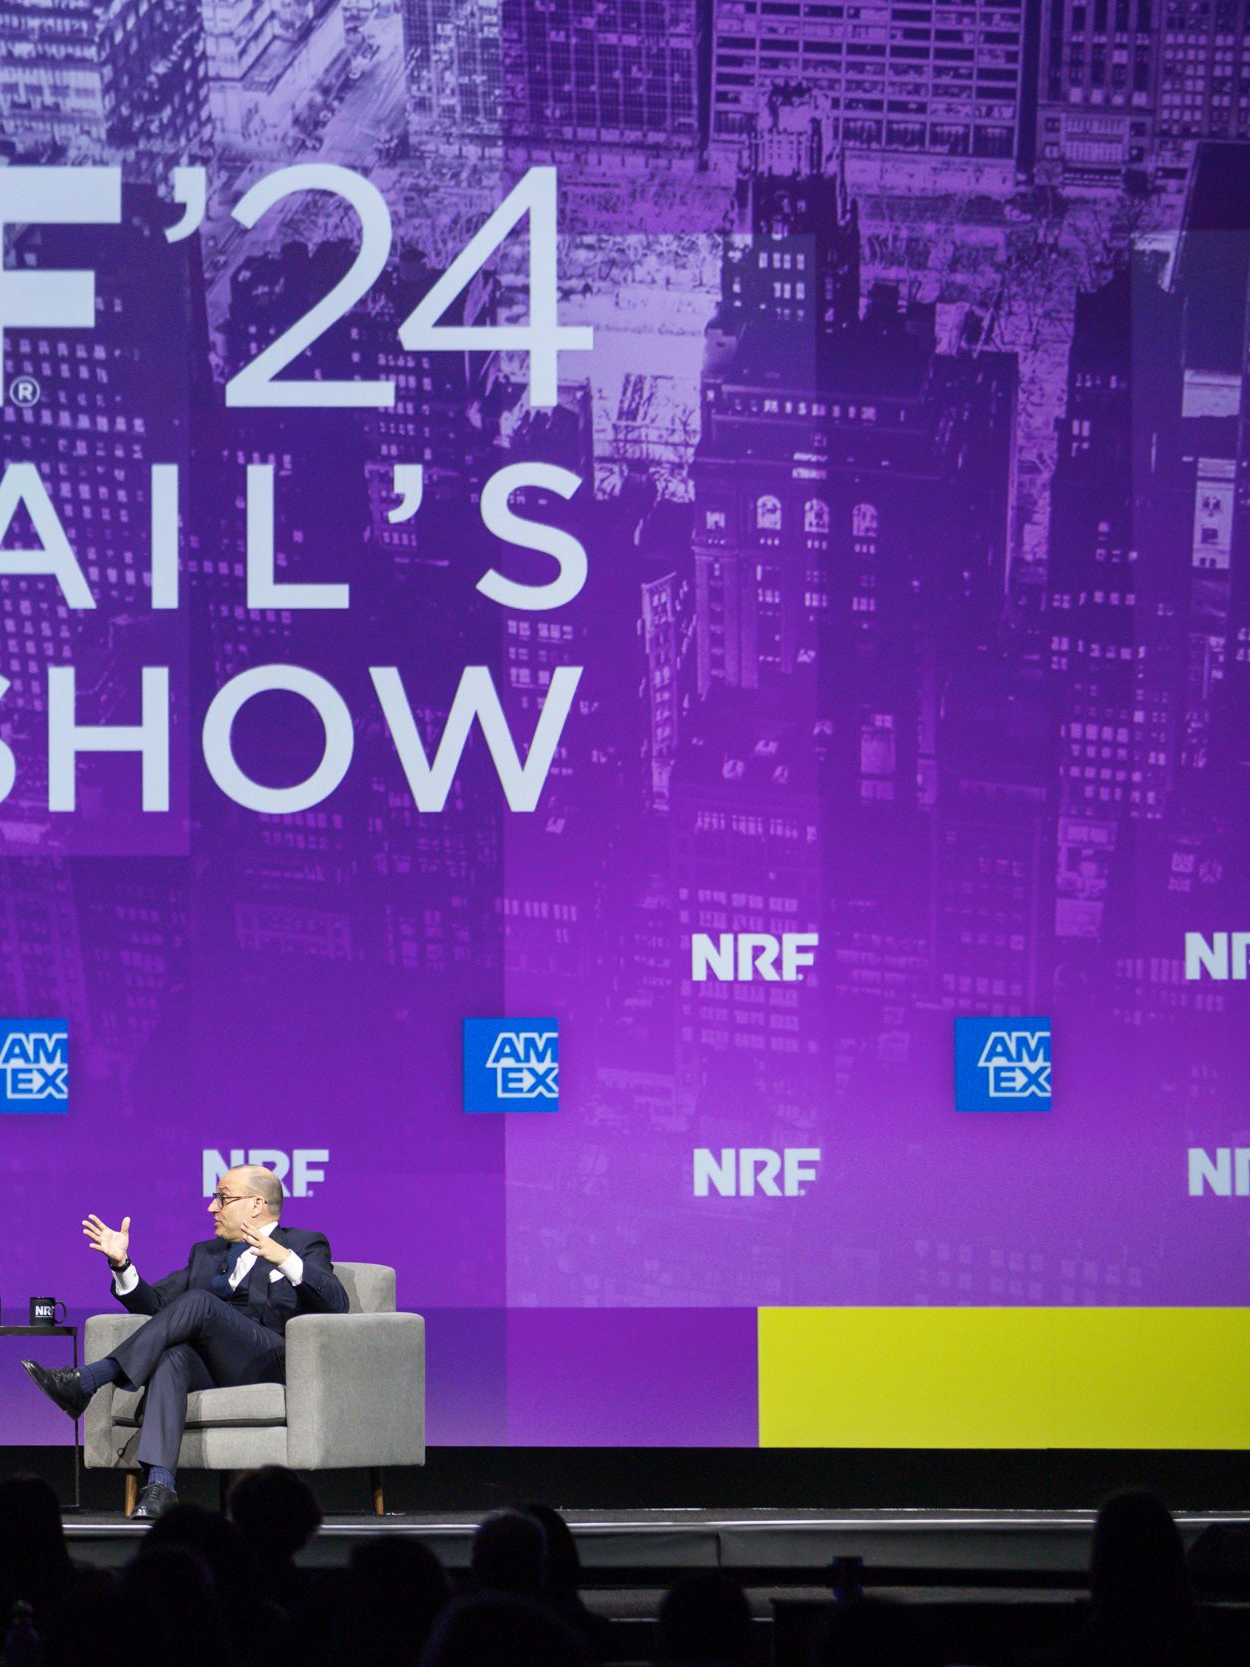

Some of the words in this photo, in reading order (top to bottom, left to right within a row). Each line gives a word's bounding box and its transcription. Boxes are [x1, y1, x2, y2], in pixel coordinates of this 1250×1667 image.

[691, 932, 819, 981] NRF
[693, 1148, 821, 1197] NRF
[35, 1305, 55, 1316] NR
